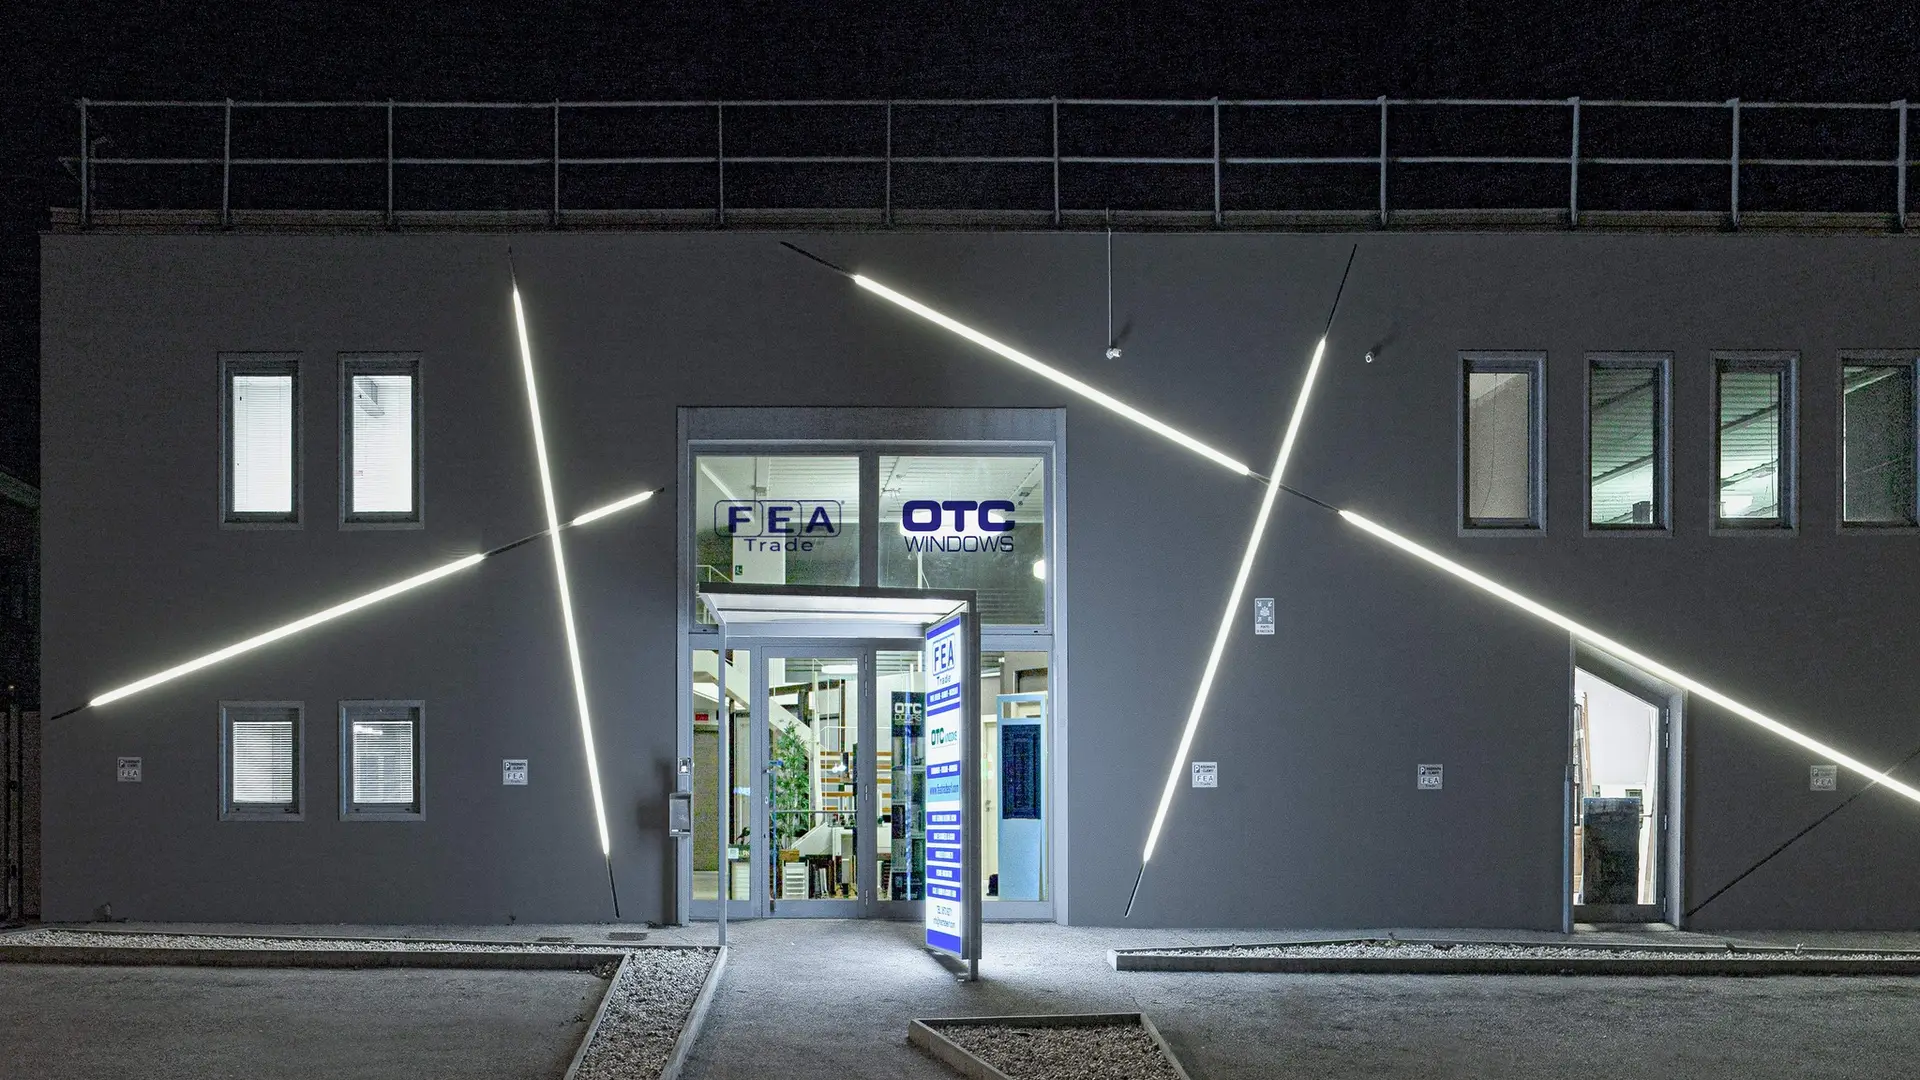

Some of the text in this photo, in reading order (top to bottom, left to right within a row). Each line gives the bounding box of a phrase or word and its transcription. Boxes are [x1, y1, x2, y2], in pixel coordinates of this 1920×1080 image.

[728, 506, 835, 533] FEA
[902, 500, 1016, 532] OTC
[744, 538, 814, 552] Trade
[904, 536, 1014, 552] WINDOWS
[934, 640, 954, 672] FEA
[895, 702, 922, 714] OTC
[931, 727, 944, 746] OTC
